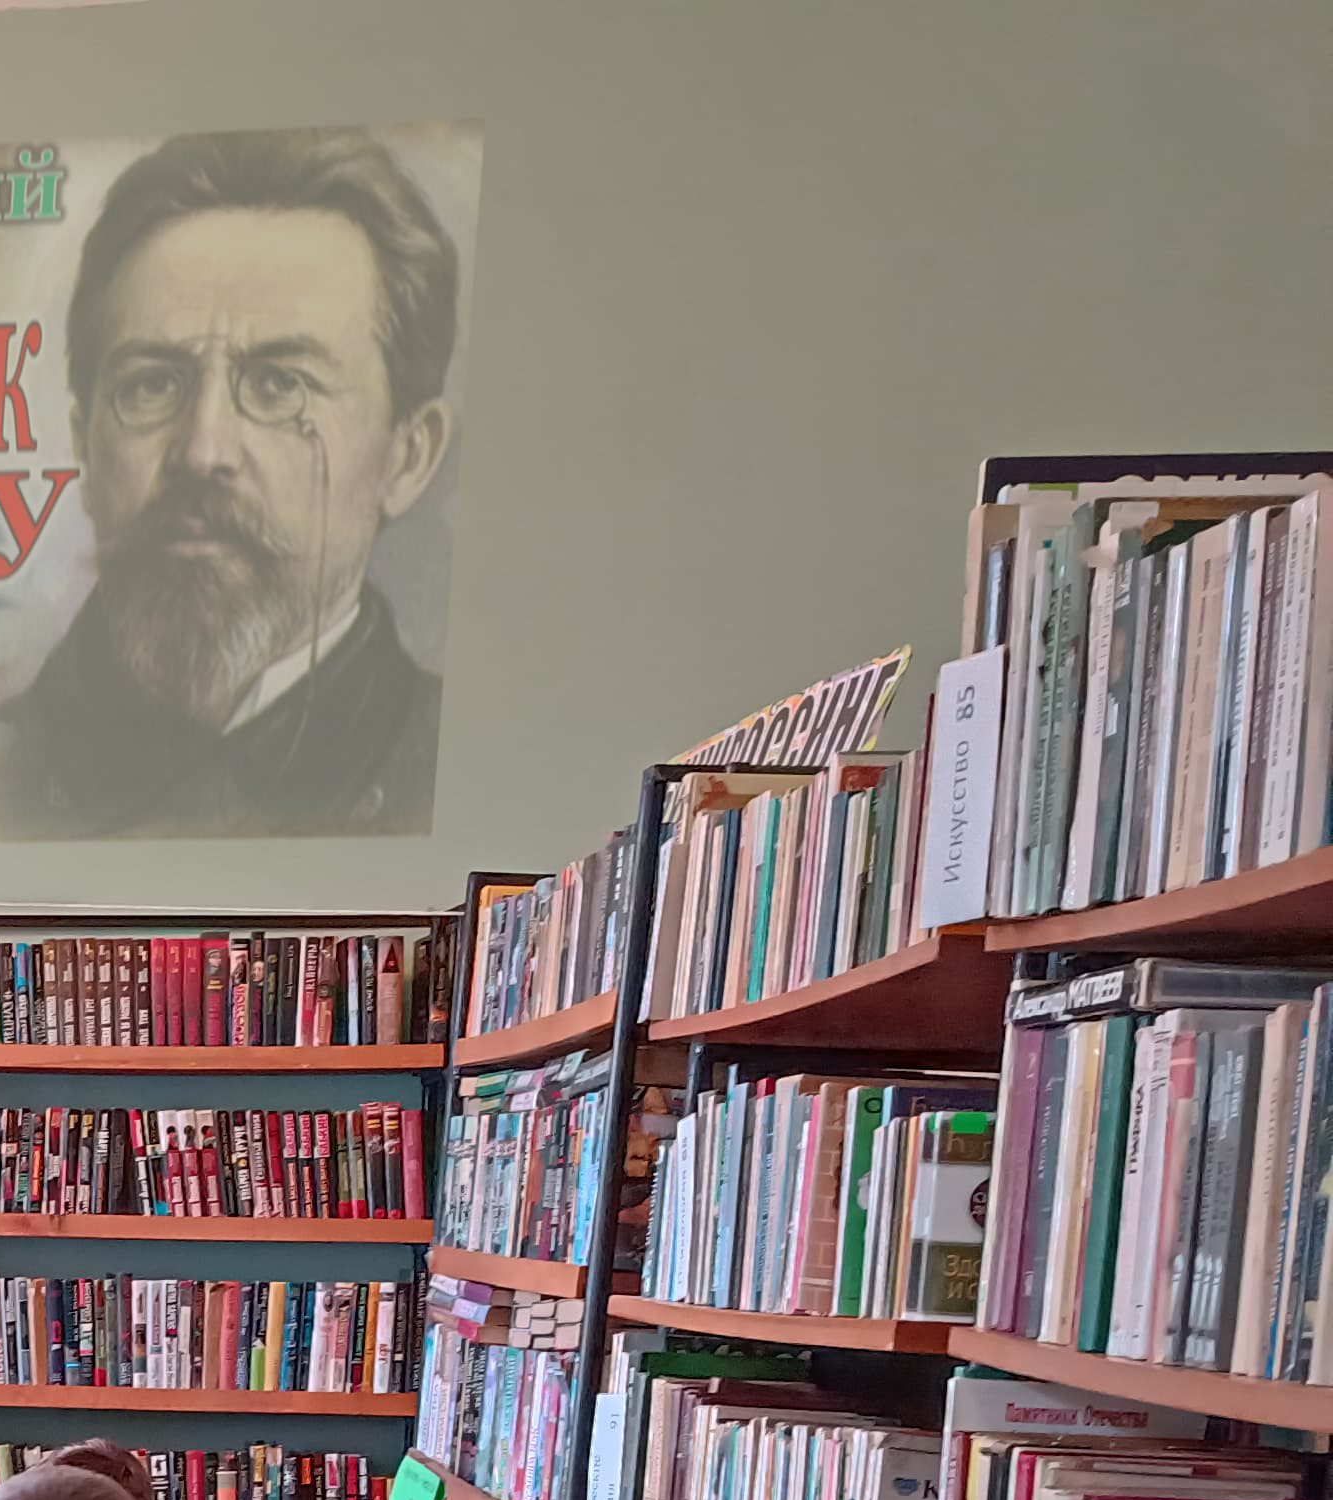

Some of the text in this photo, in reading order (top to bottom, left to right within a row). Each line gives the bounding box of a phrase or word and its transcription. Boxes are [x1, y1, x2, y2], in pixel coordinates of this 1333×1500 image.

[686, 655, 904, 766] РОССИНГ
[942, 683, 975, 886] Искусство 85
[609, 1412, 620, 1430] 91
